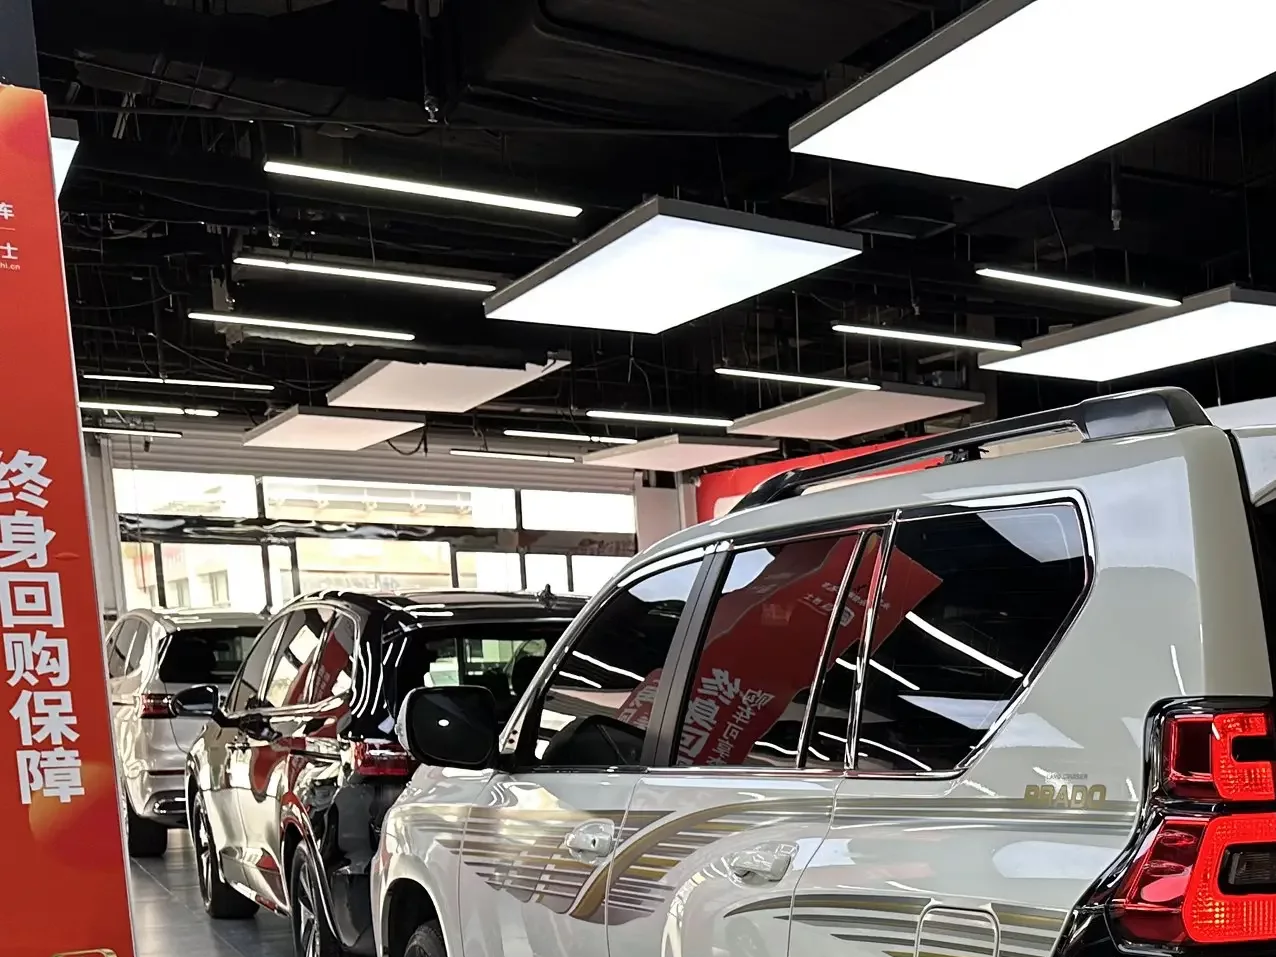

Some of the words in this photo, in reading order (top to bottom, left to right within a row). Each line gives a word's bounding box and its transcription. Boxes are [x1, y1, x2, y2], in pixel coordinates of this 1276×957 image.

[0, 449, 85, 804] 终身回购保障
[1024, 784, 1107, 808] PRADO
